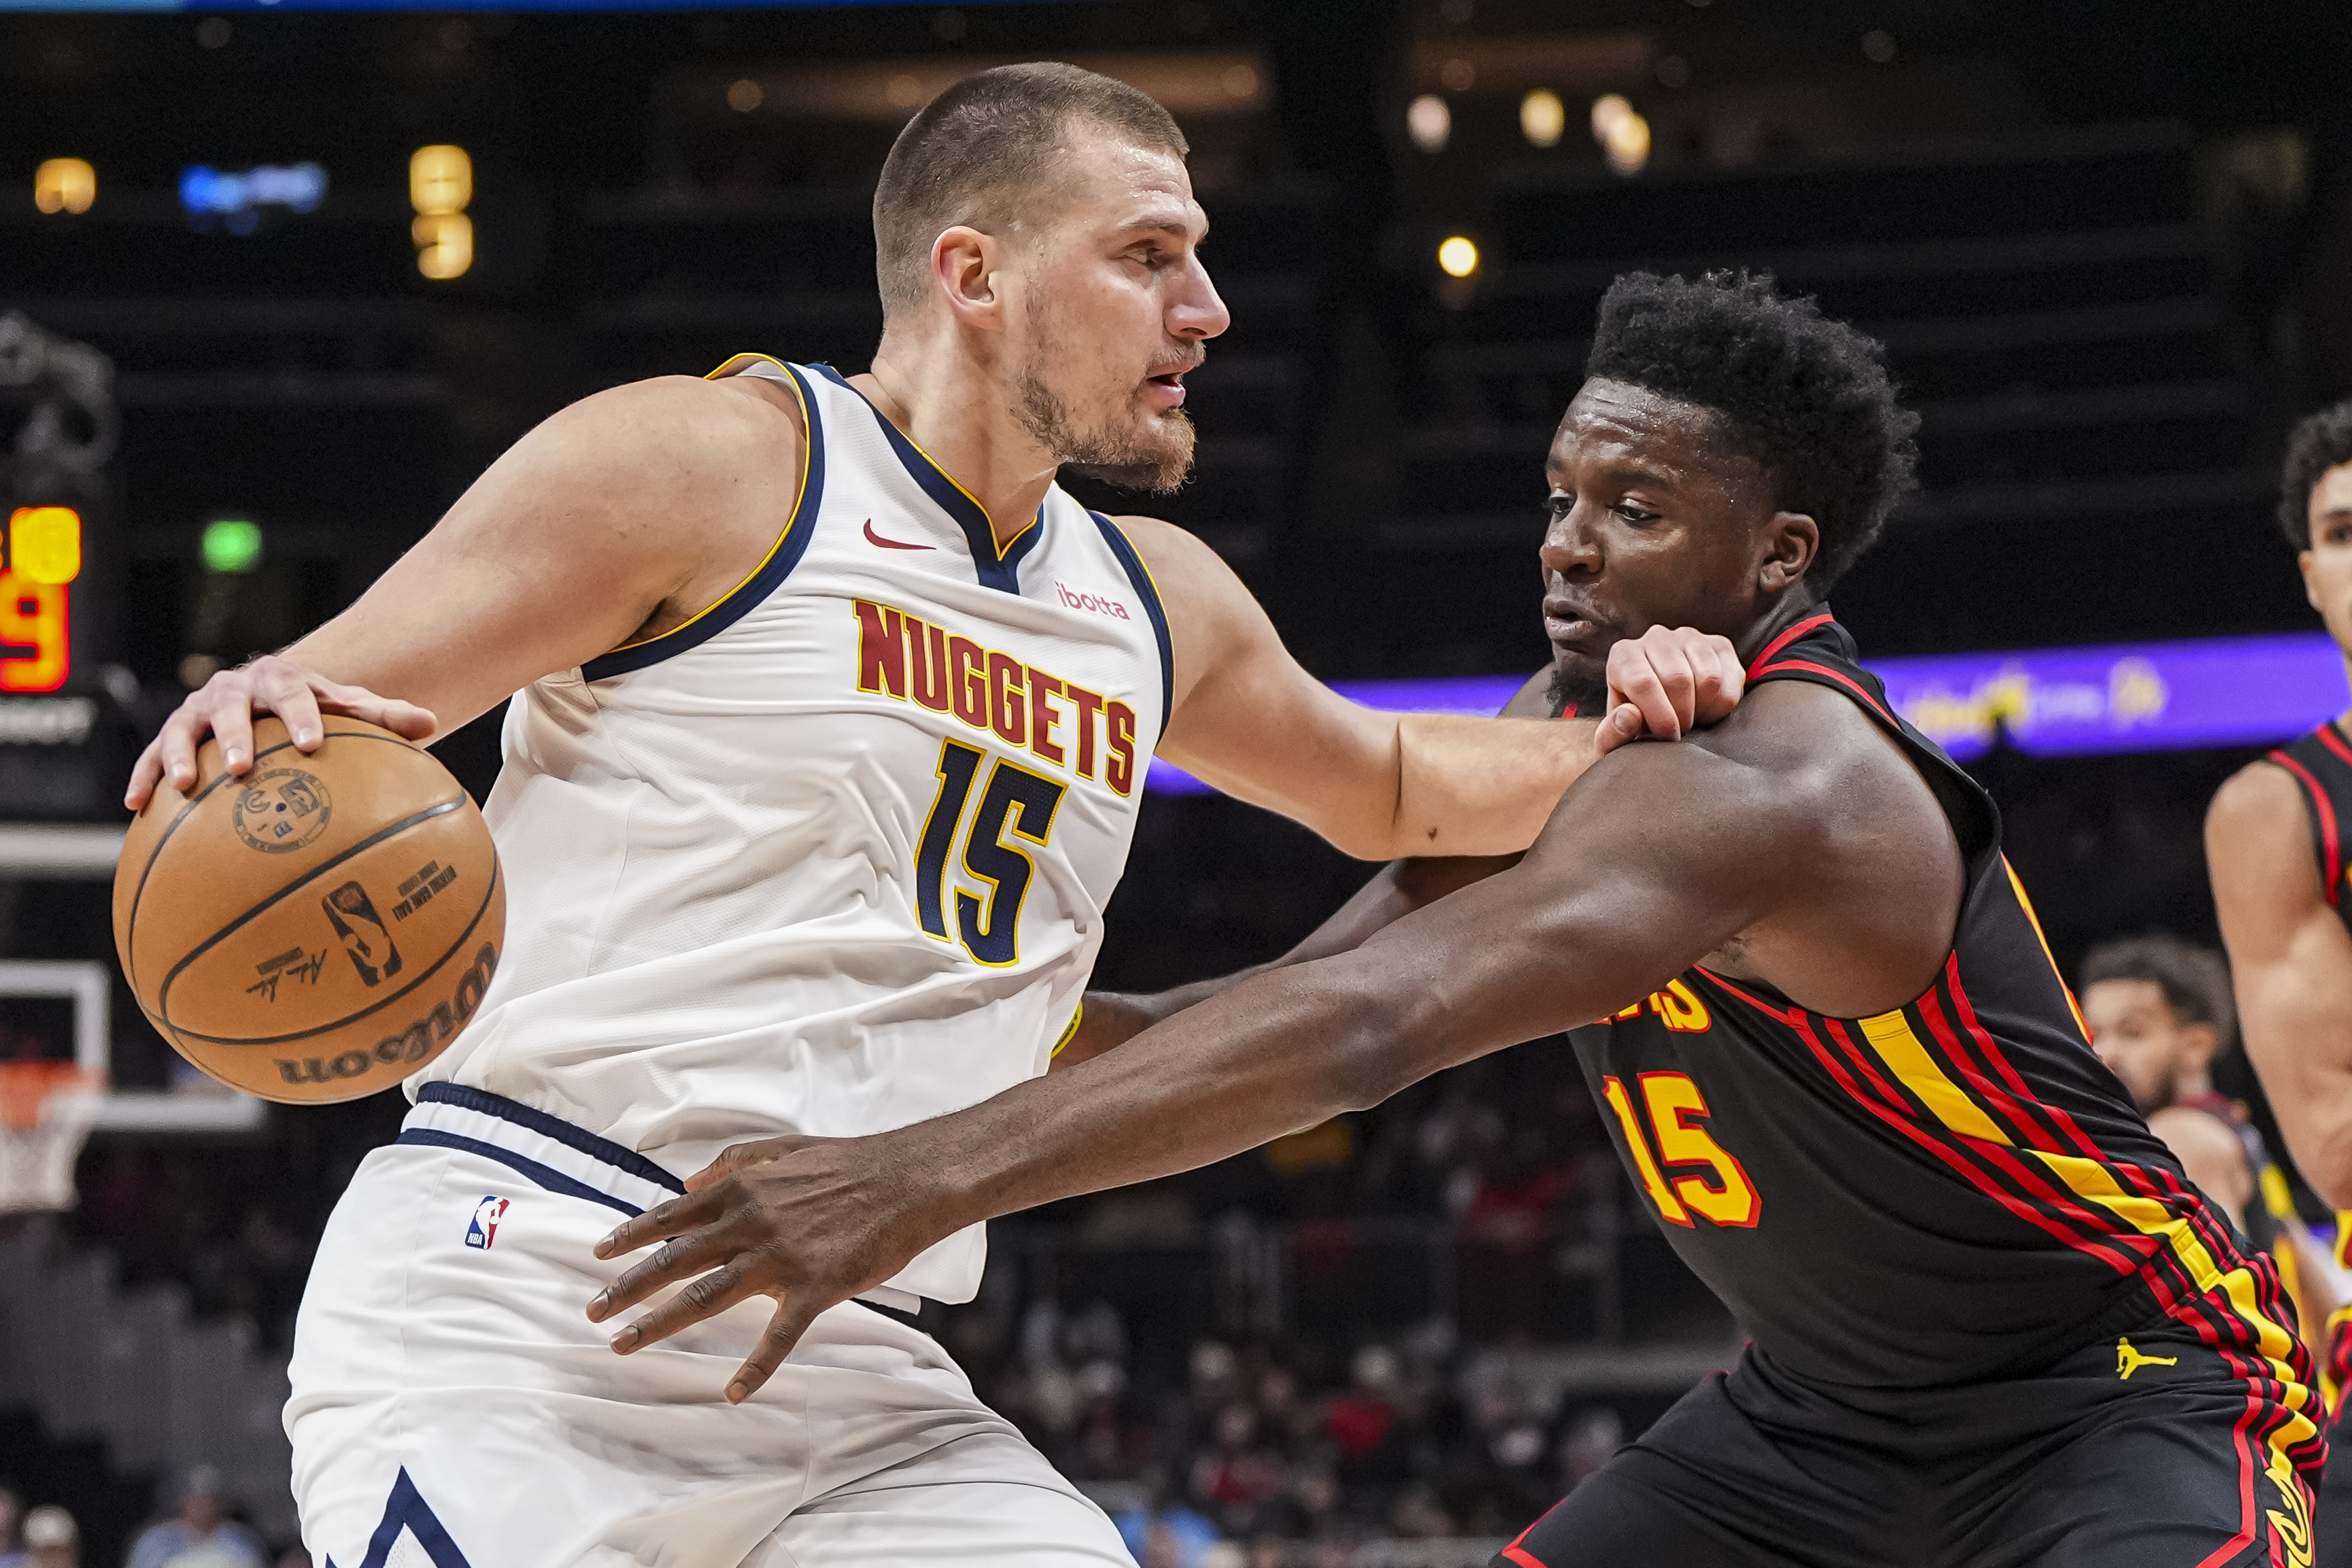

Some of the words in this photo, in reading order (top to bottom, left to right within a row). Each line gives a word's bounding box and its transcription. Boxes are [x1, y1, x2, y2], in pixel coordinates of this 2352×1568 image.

[1055, 581, 1131, 620] ibotta
[851, 598, 1136, 797] NUGGETS
[915, 736, 1070, 968] 15
[275, 941, 497, 1085] Wilson
[1602, 1070, 1762, 1228] 15
[467, 1233, 483, 1246] NBA
